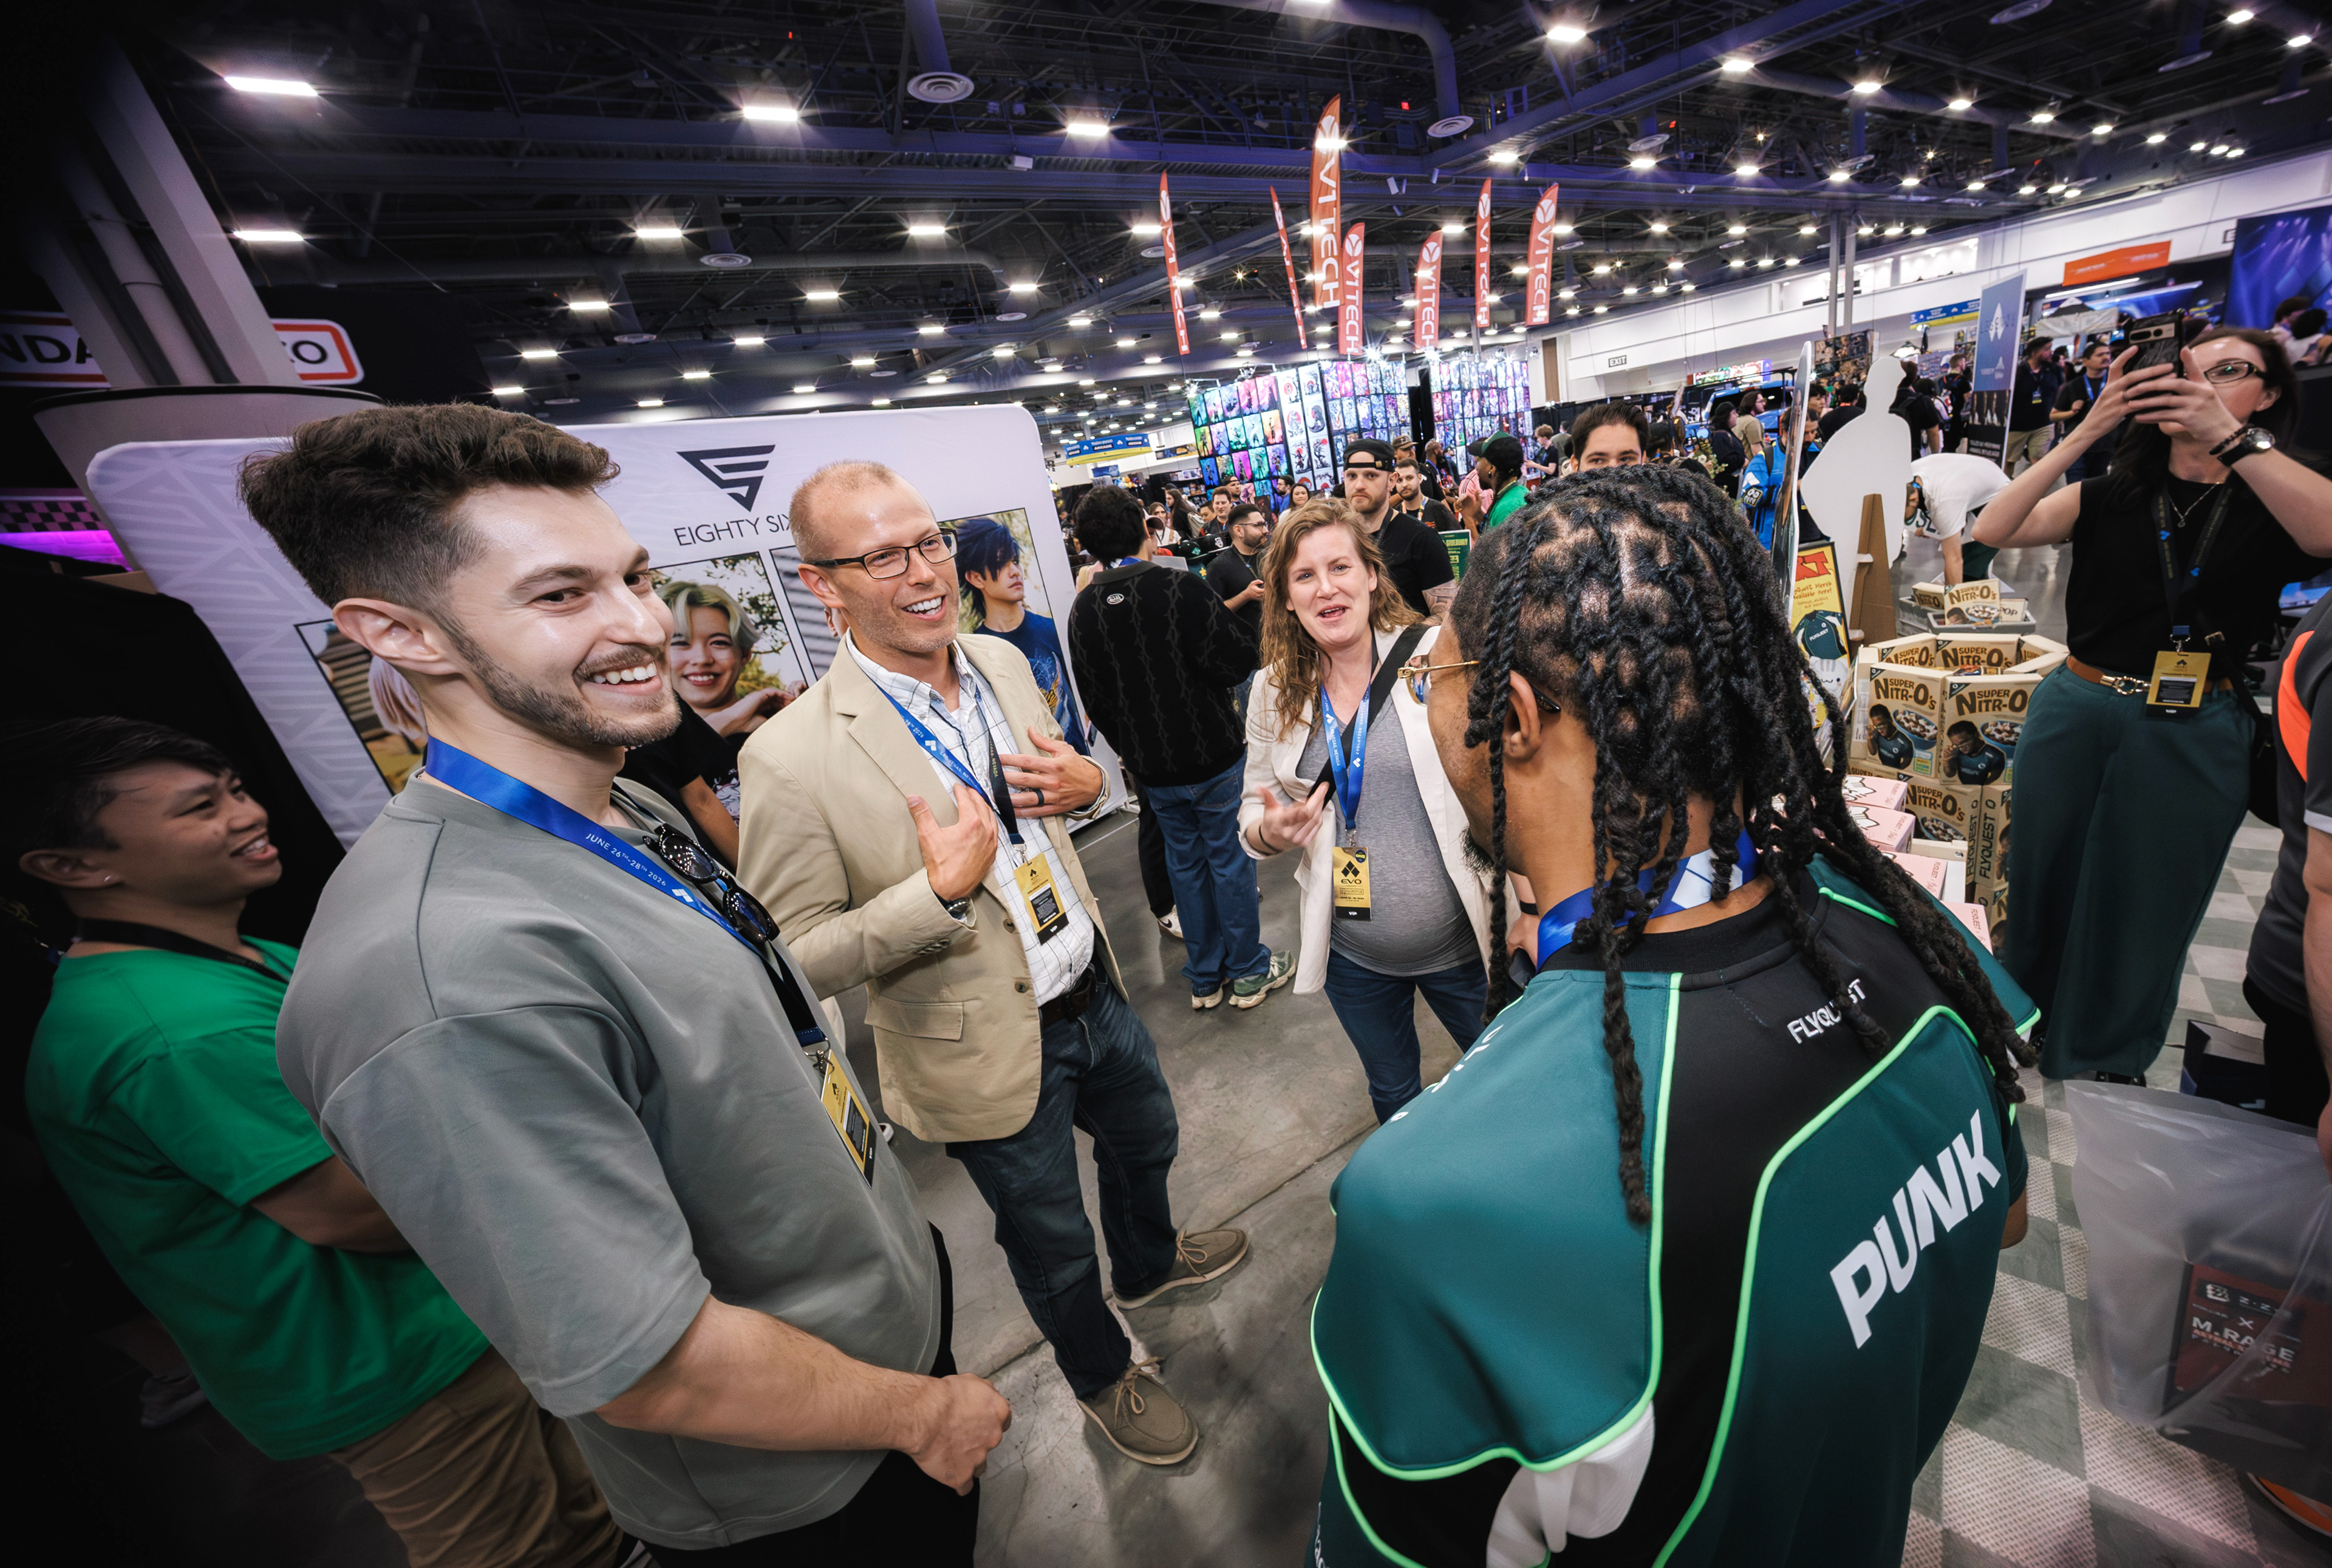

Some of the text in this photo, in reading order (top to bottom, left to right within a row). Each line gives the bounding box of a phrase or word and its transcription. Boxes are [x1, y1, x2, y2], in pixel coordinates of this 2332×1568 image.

[1532, 225, 1552, 322] V1TECH
[1346, 259, 1360, 355] V1TECH
[1609, 355, 1627, 367] EXIT
[674, 514, 790, 546] EIGHTY SIX
[1899, 647, 1919, 658] SUPER
[1959, 647, 1987, 655] SUPER
[1889, 678, 1914, 689] SUPER
[1977, 689, 2010, 698] SUPER
[913, 727, 924, 738] 2026
[1917, 786, 1943, 798] SUPER
[1979, 813, 1996, 879] FLYQUEST
[585, 833, 610, 850] JUNE
[648, 871, 666, 886] 2026
[1787, 978, 1866, 1044] FLYQUST
[1829, 1108, 2002, 1349] PUNK
